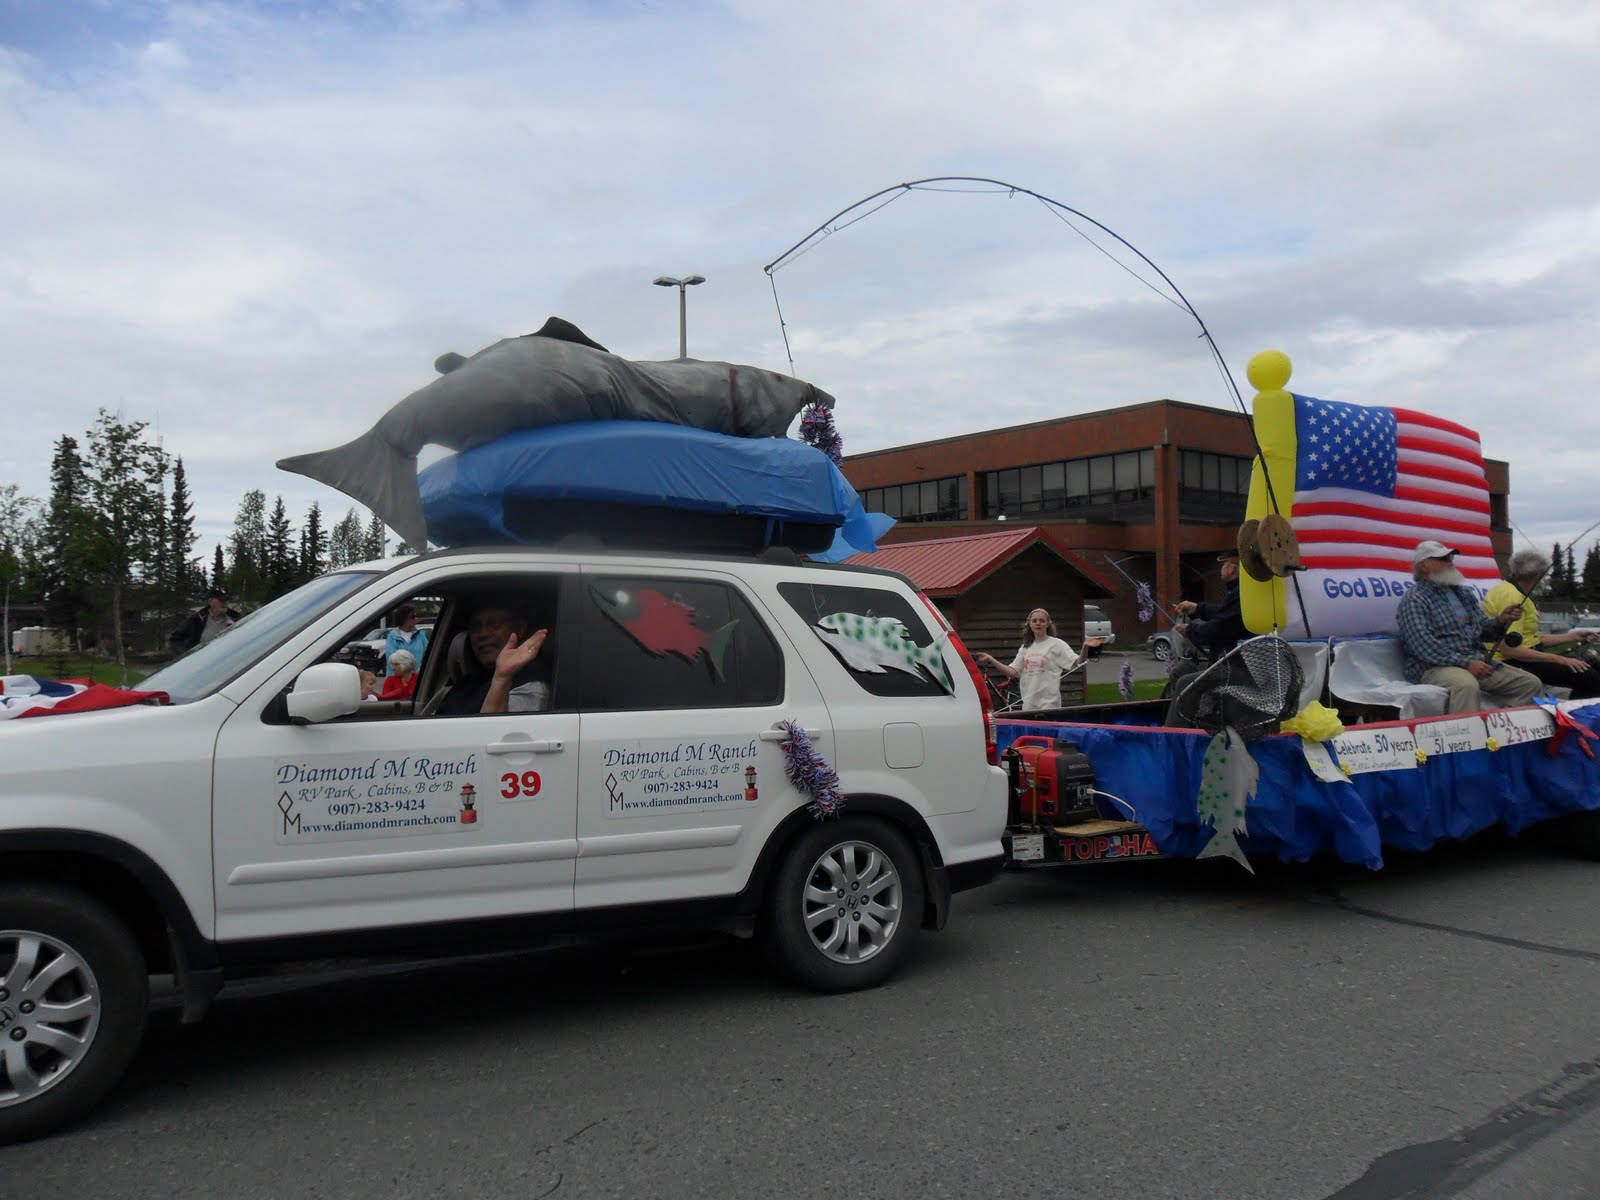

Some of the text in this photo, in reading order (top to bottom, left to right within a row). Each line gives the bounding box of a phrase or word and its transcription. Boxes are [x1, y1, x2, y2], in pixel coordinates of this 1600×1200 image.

[1323, 577, 1414, 599] God Bles
[1488, 711, 1514, 728] USA
[1505, 724, 1554, 744] 234 years
[603, 740, 758, 767] Diamond M Ranch
[1333, 734, 1414, 757] Celebrate 50 years
[1434, 738, 1472, 754] 51 years
[277, 754, 477, 784] Diamond M Ranch
[621, 769, 641, 782] RV
[298, 785, 324, 801] RV
[415, 780, 427, 794] B
[442, 780, 454, 792] B
[500, 771, 542, 799] 39
[643, 779, 719, 794] (907)-283-9424
[327, 799, 426, 816] (907)-283-9424
[624, 793, 743, 810] www.diamondmranch.com
[302, 814, 456, 834] www.diamondmranch.com
[1058, 837, 1109, 861] TOP
